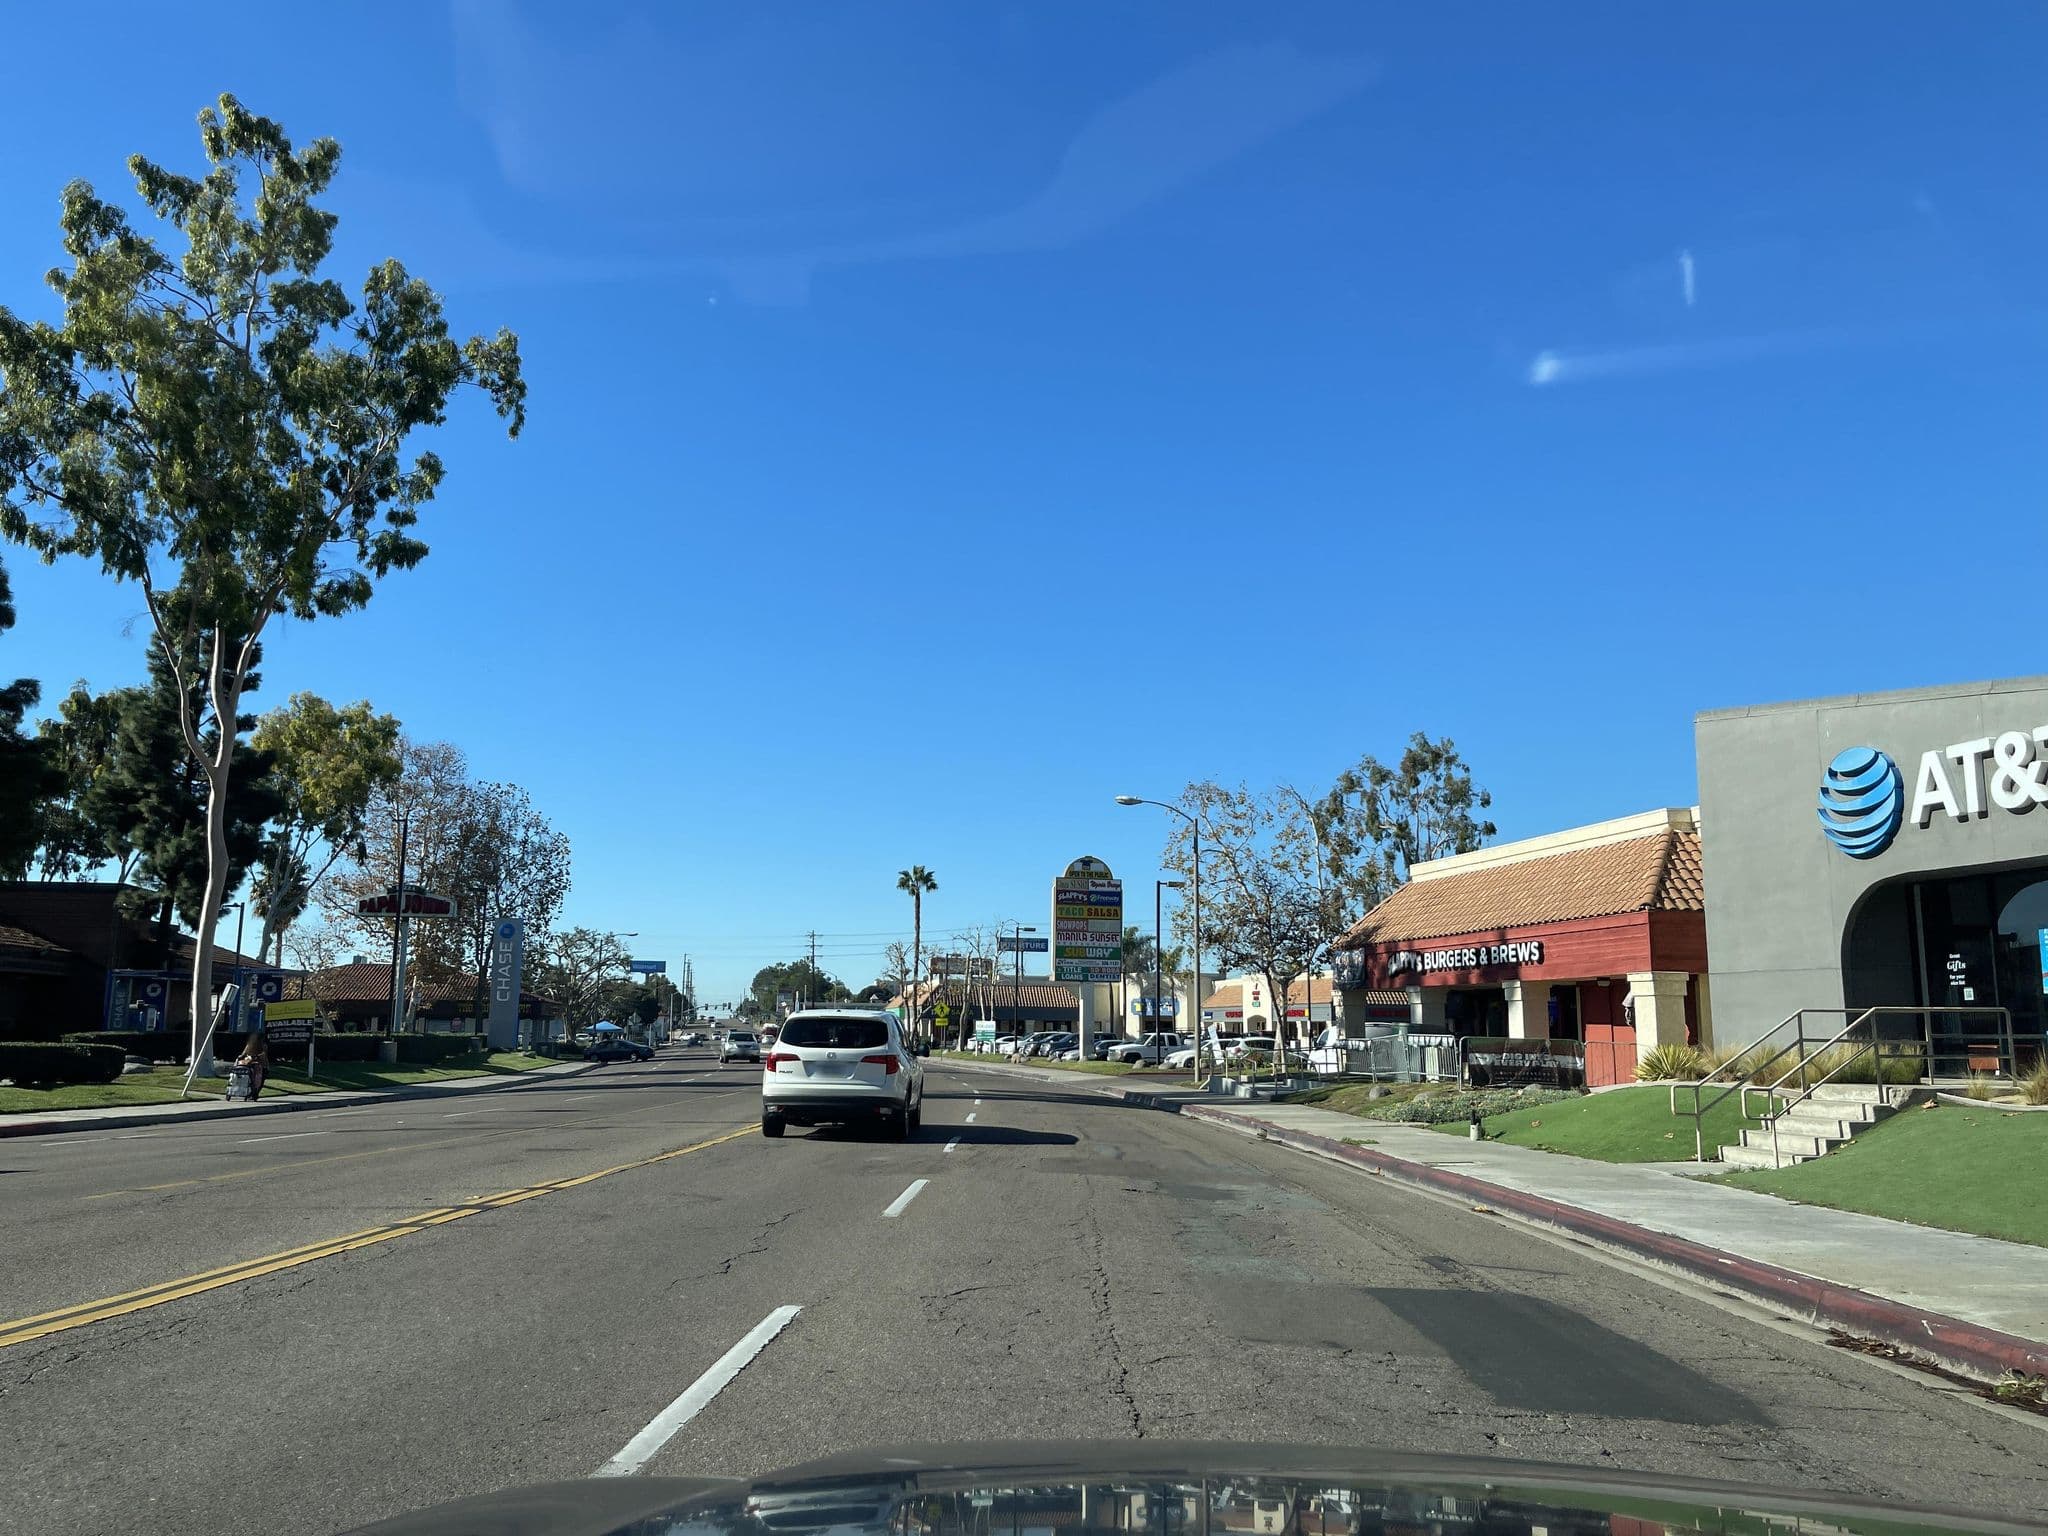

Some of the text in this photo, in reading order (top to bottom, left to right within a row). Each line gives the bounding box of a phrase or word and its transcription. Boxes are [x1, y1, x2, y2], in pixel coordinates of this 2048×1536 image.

[1057, 906, 1119, 917] TACO SALSA
[1057, 932, 1120, 943] MANILA SUNSET
[1064, 947, 1112, 958] SUBWAY
[1423, 948, 1477, 970] BURGERS
[1479, 947, 1488, 964] &
[1491, 941, 1540, 964] BREWS
[496, 941, 513, 1002] CHASE
[1946, 960, 1966, 972] Gifts
[266, 1019, 313, 1028] AVAILABLE
